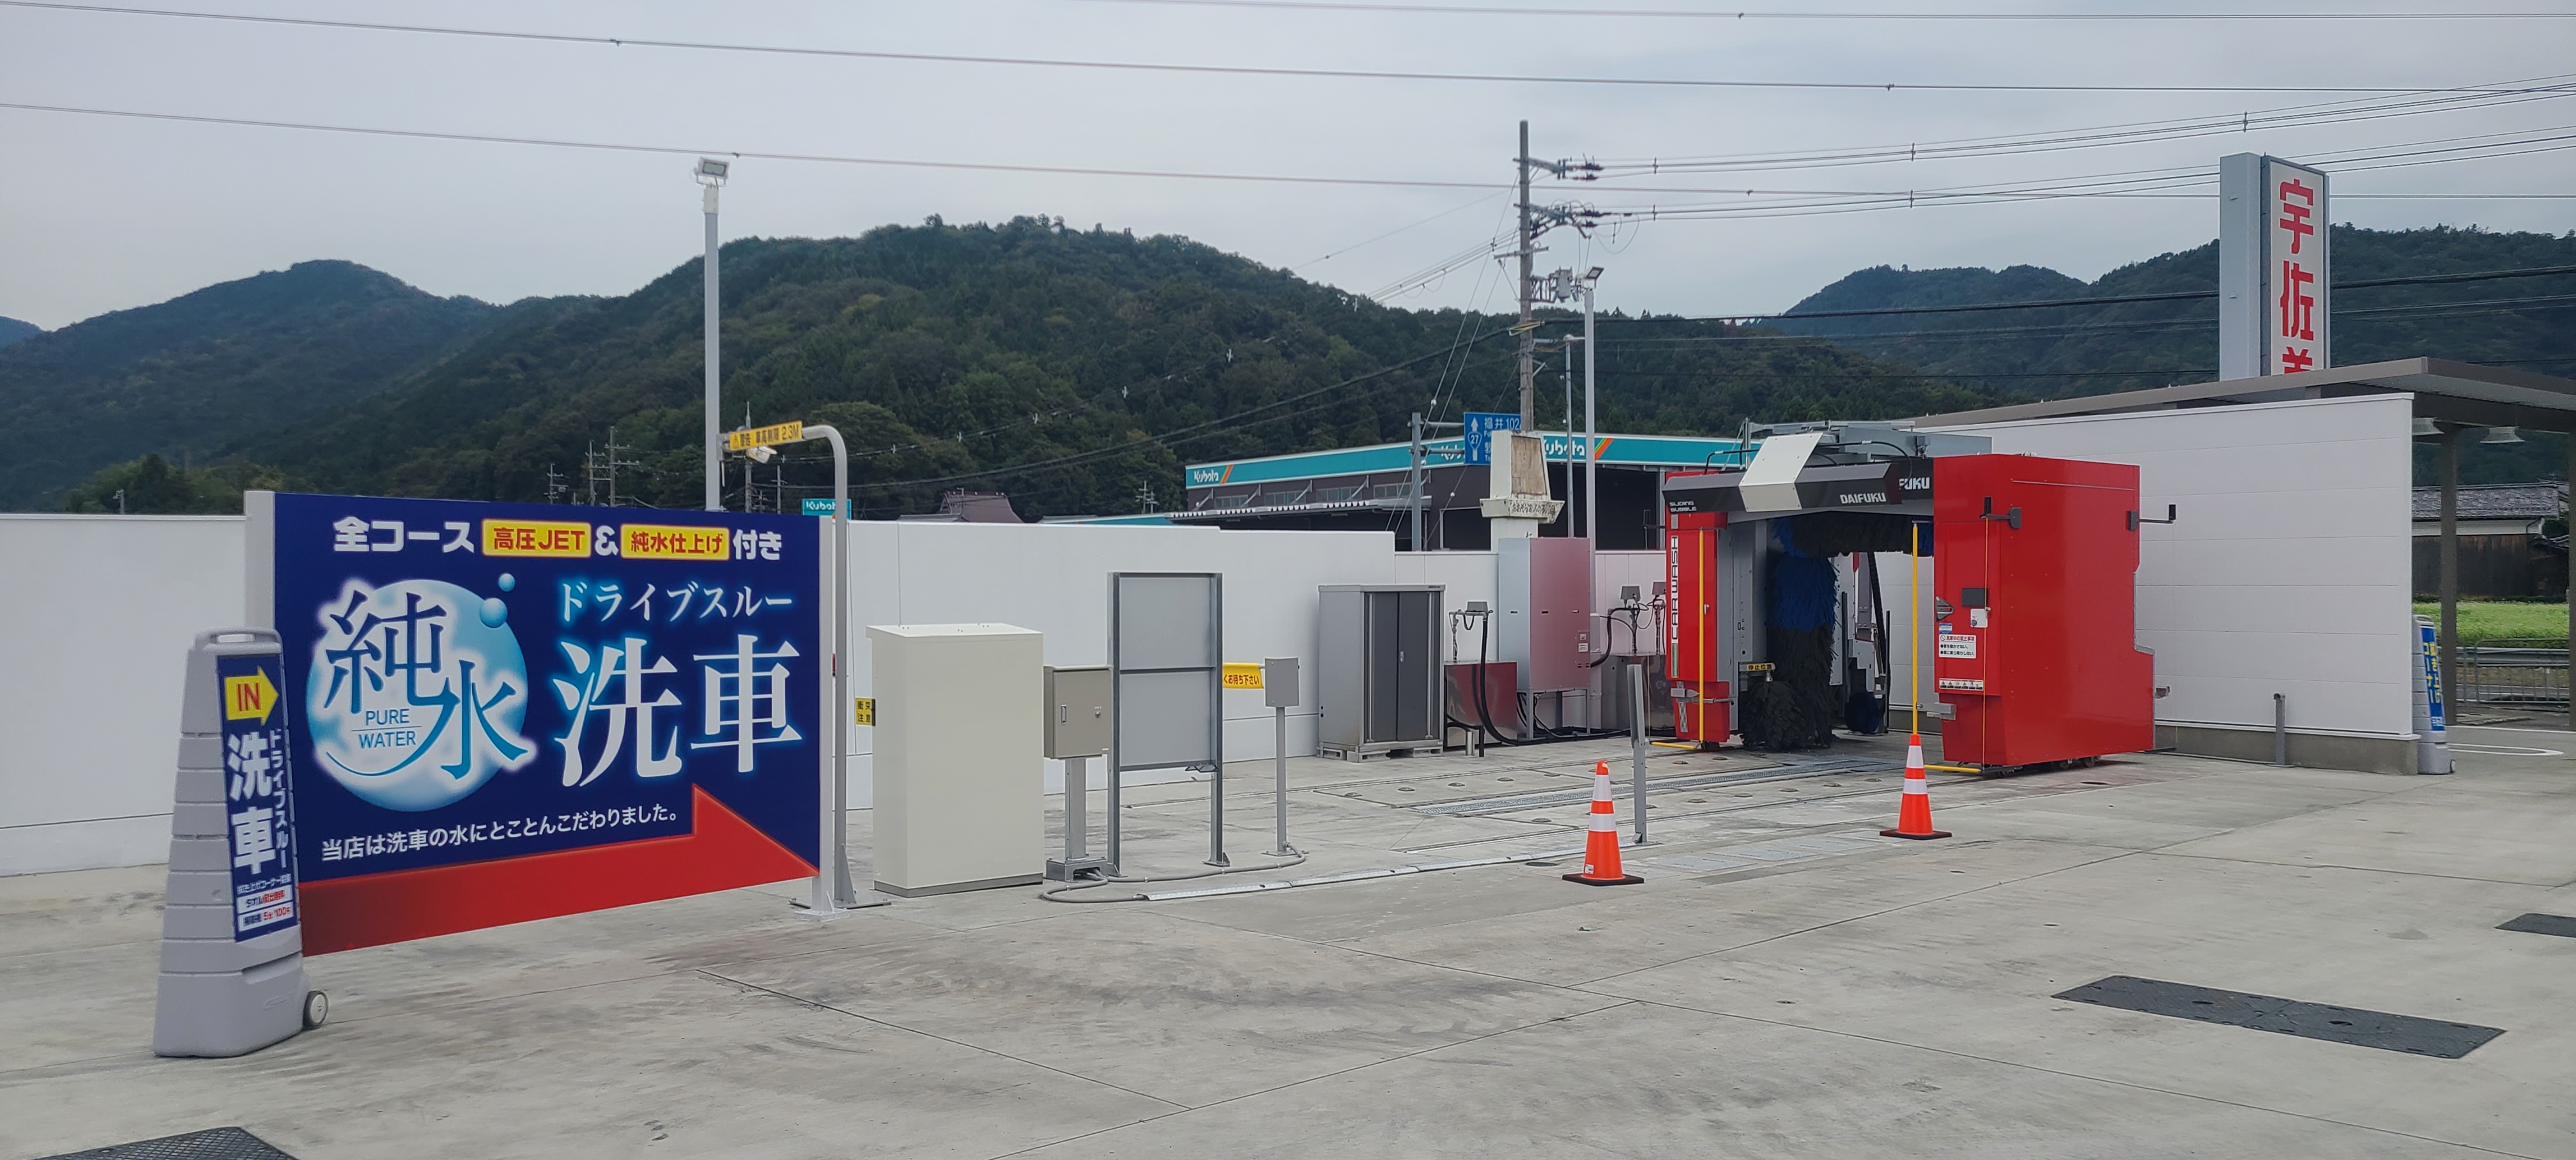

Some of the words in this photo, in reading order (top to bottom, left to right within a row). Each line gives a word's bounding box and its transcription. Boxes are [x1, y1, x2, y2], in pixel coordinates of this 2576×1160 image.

[1483, 417, 1503, 429] 福井
[1470, 434, 1479, 444] 27
[1193, 468, 1219, 483] Kubota
[1839, 492, 1887, 504] DAIFUKU
[333, 516, 475, 553] 全コース
[493, 527, 586, 551] 高圧JET
[594, 525, 618, 557] &
[631, 531, 723, 554] 純水仕上げ
[732, 529, 783, 560] 付き
[563, 581, 792, 622] ドライブスルー
[236, 682, 261, 712] IN
[323, 590, 529, 780] 純水
[365, 708, 410, 726] PURE
[553, 634, 803, 787] 洗車
[857, 713, 871, 722] 注意
[358, 731, 417, 749] WATER
[227, 731, 276, 874] 洗車
[270, 728, 289, 869] ドライブスルー
[321, 803, 677, 861] 当店は洗車の水にとことんこだわりました。
